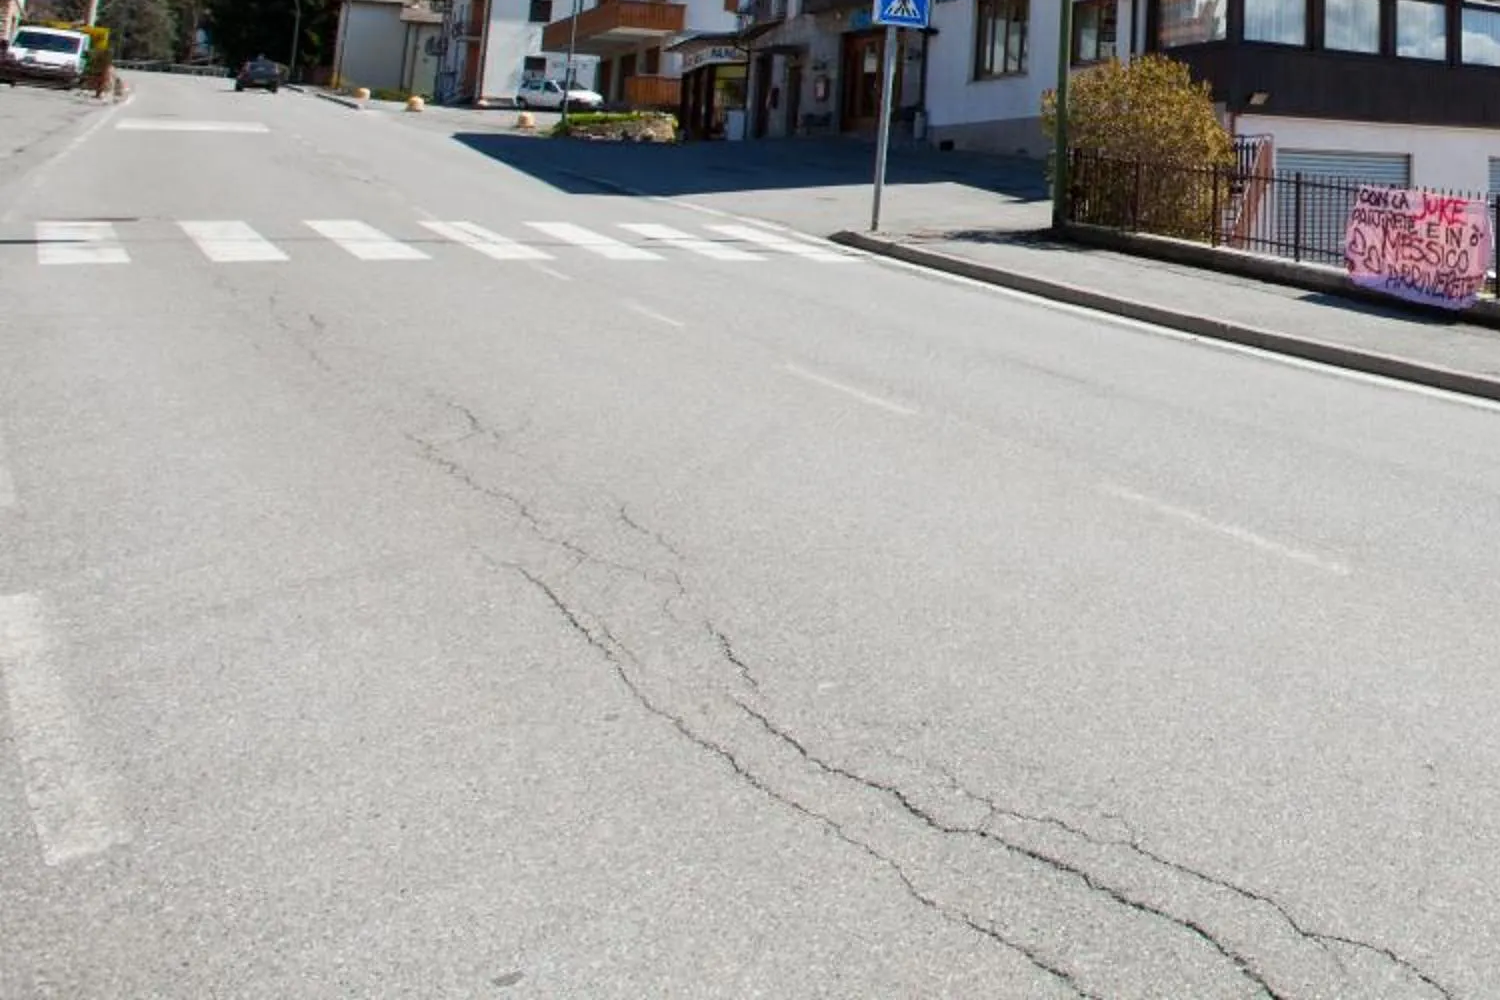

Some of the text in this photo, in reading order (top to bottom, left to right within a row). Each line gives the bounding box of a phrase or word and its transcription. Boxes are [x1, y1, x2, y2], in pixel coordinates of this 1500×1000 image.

[1413, 192, 1468, 226] JUKE
[1381, 218, 1468, 273] MESSICO
[1445, 227, 1462, 248] IN
